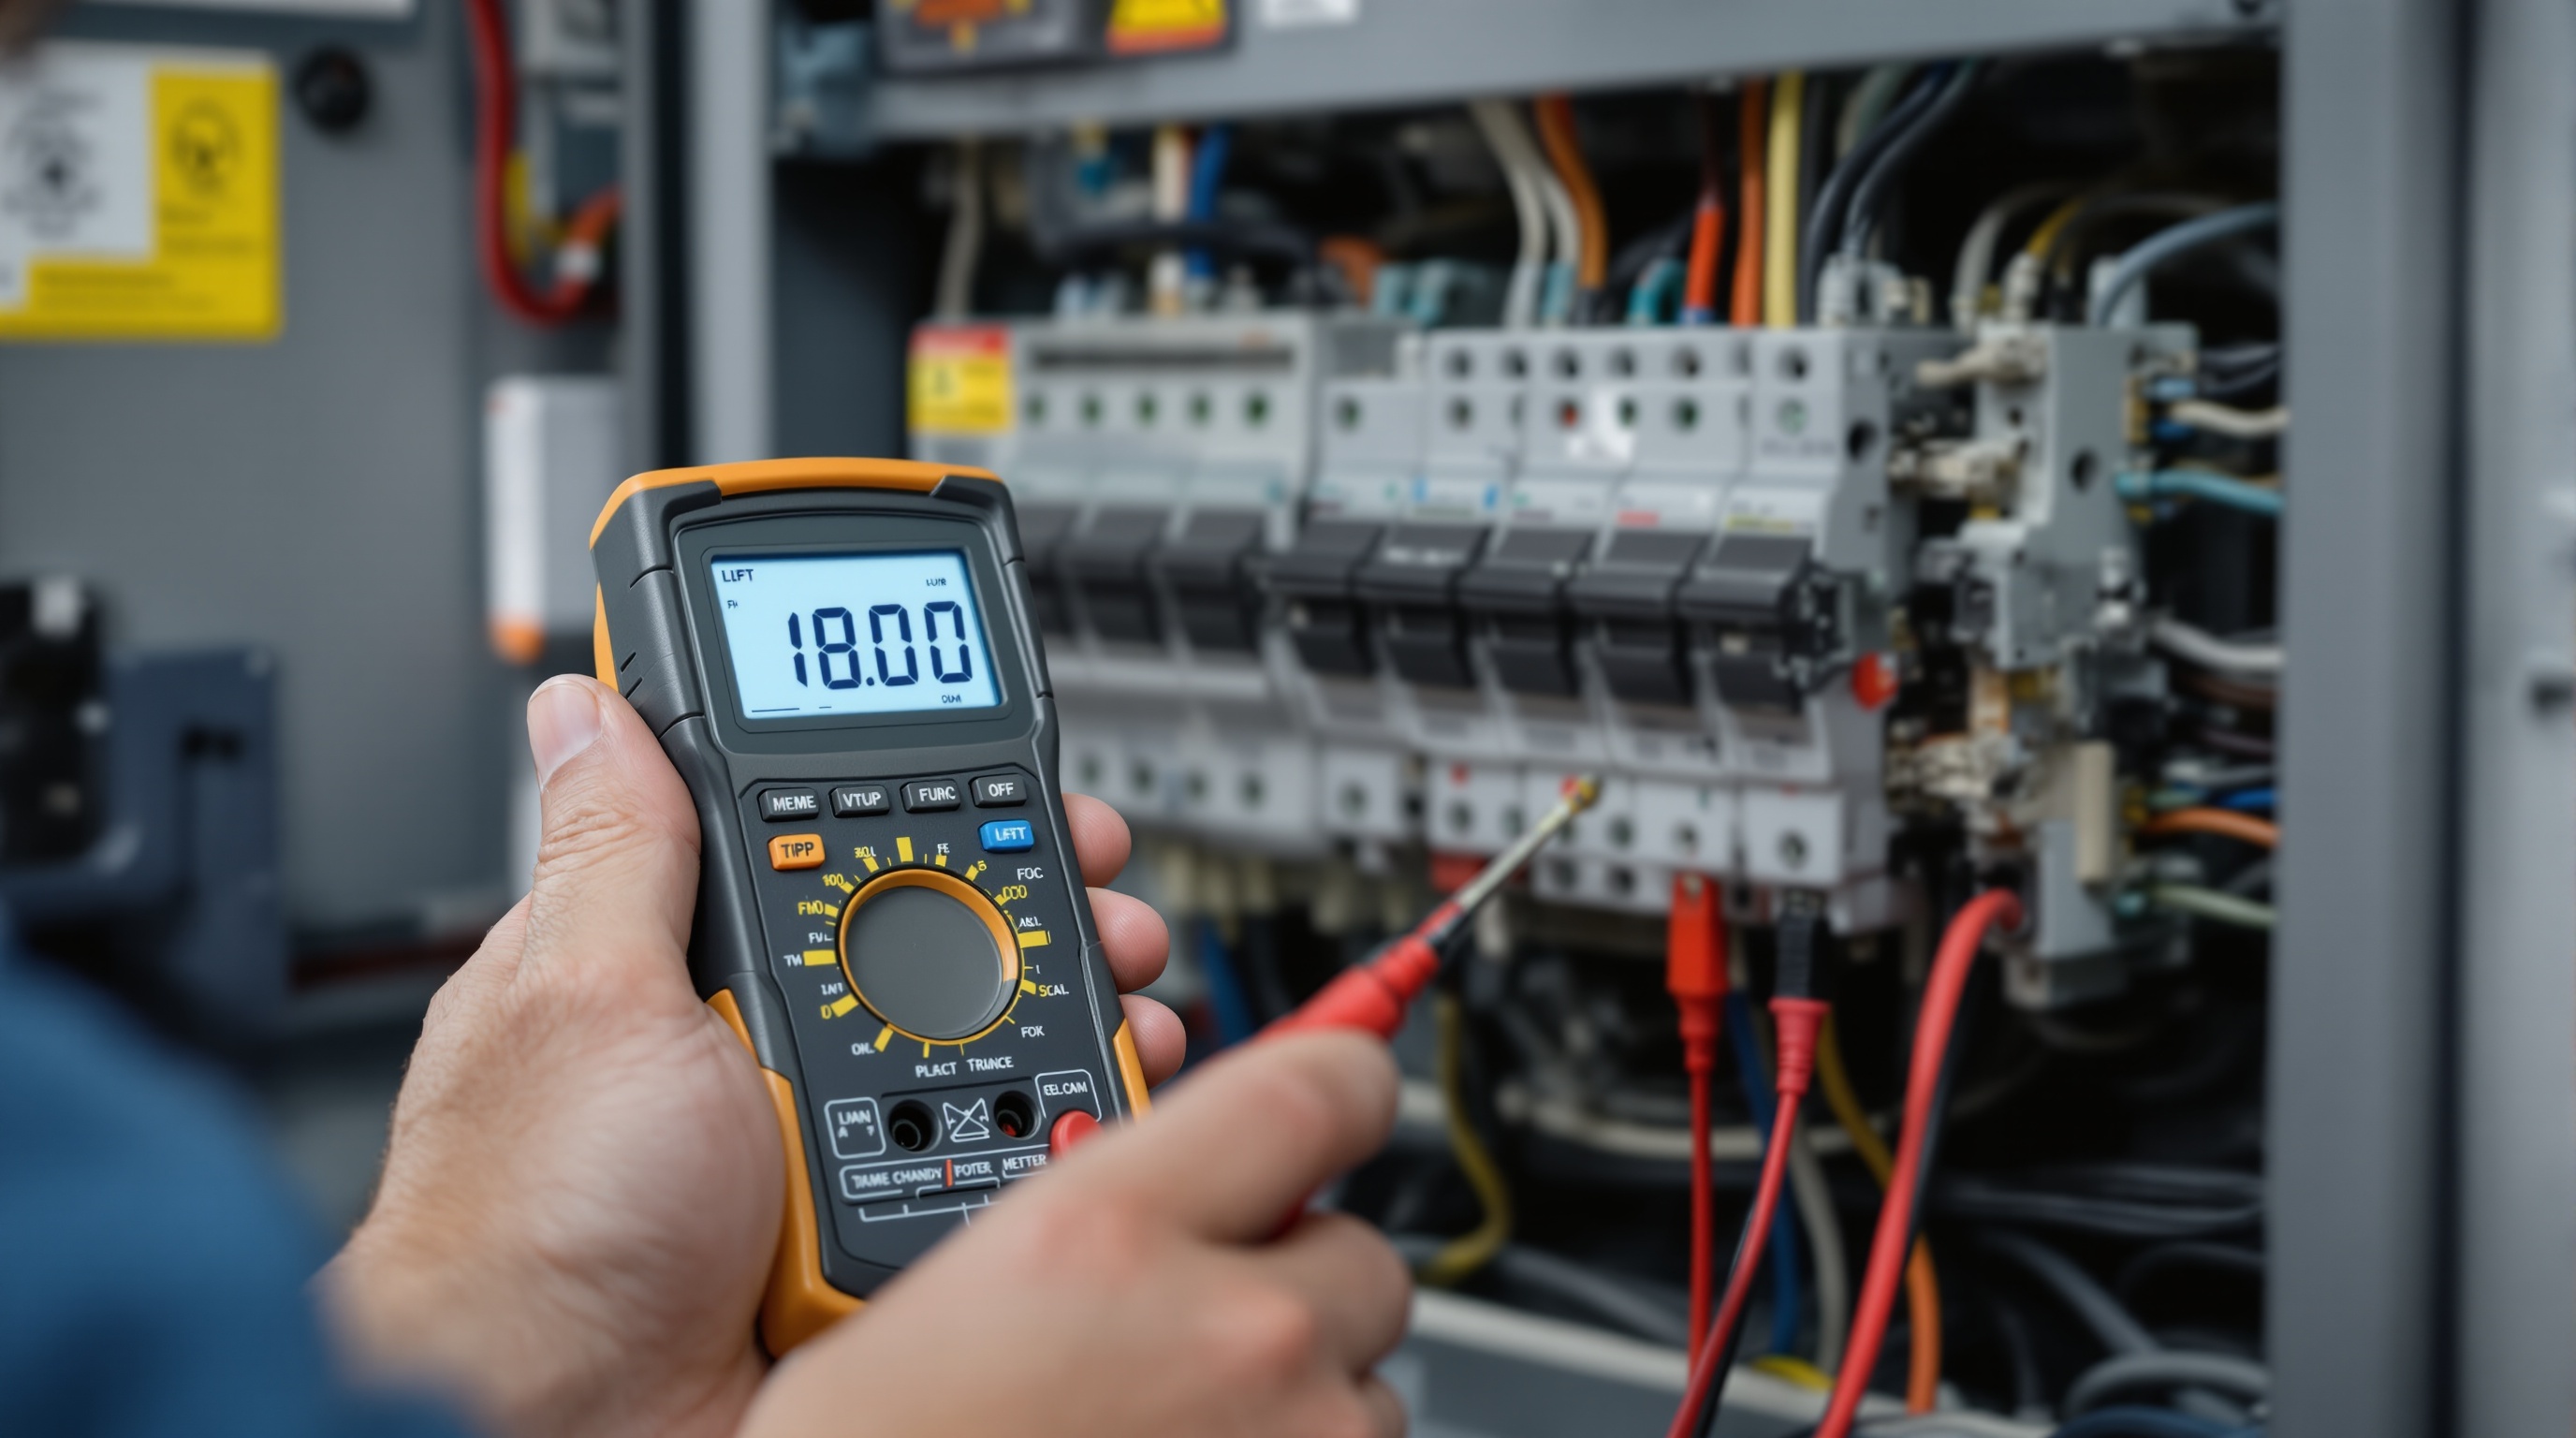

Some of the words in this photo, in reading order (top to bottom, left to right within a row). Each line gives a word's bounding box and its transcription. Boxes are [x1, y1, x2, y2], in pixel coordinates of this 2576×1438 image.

[788, 601, 973, 689] 18.00
[988, 783, 1014, 797] OFF
[773, 796, 816, 812] MEME
[842, 792, 881, 807] VTUP
[1017, 867, 1044, 880] FOC
[1038, 984, 1069, 997] SCAL
